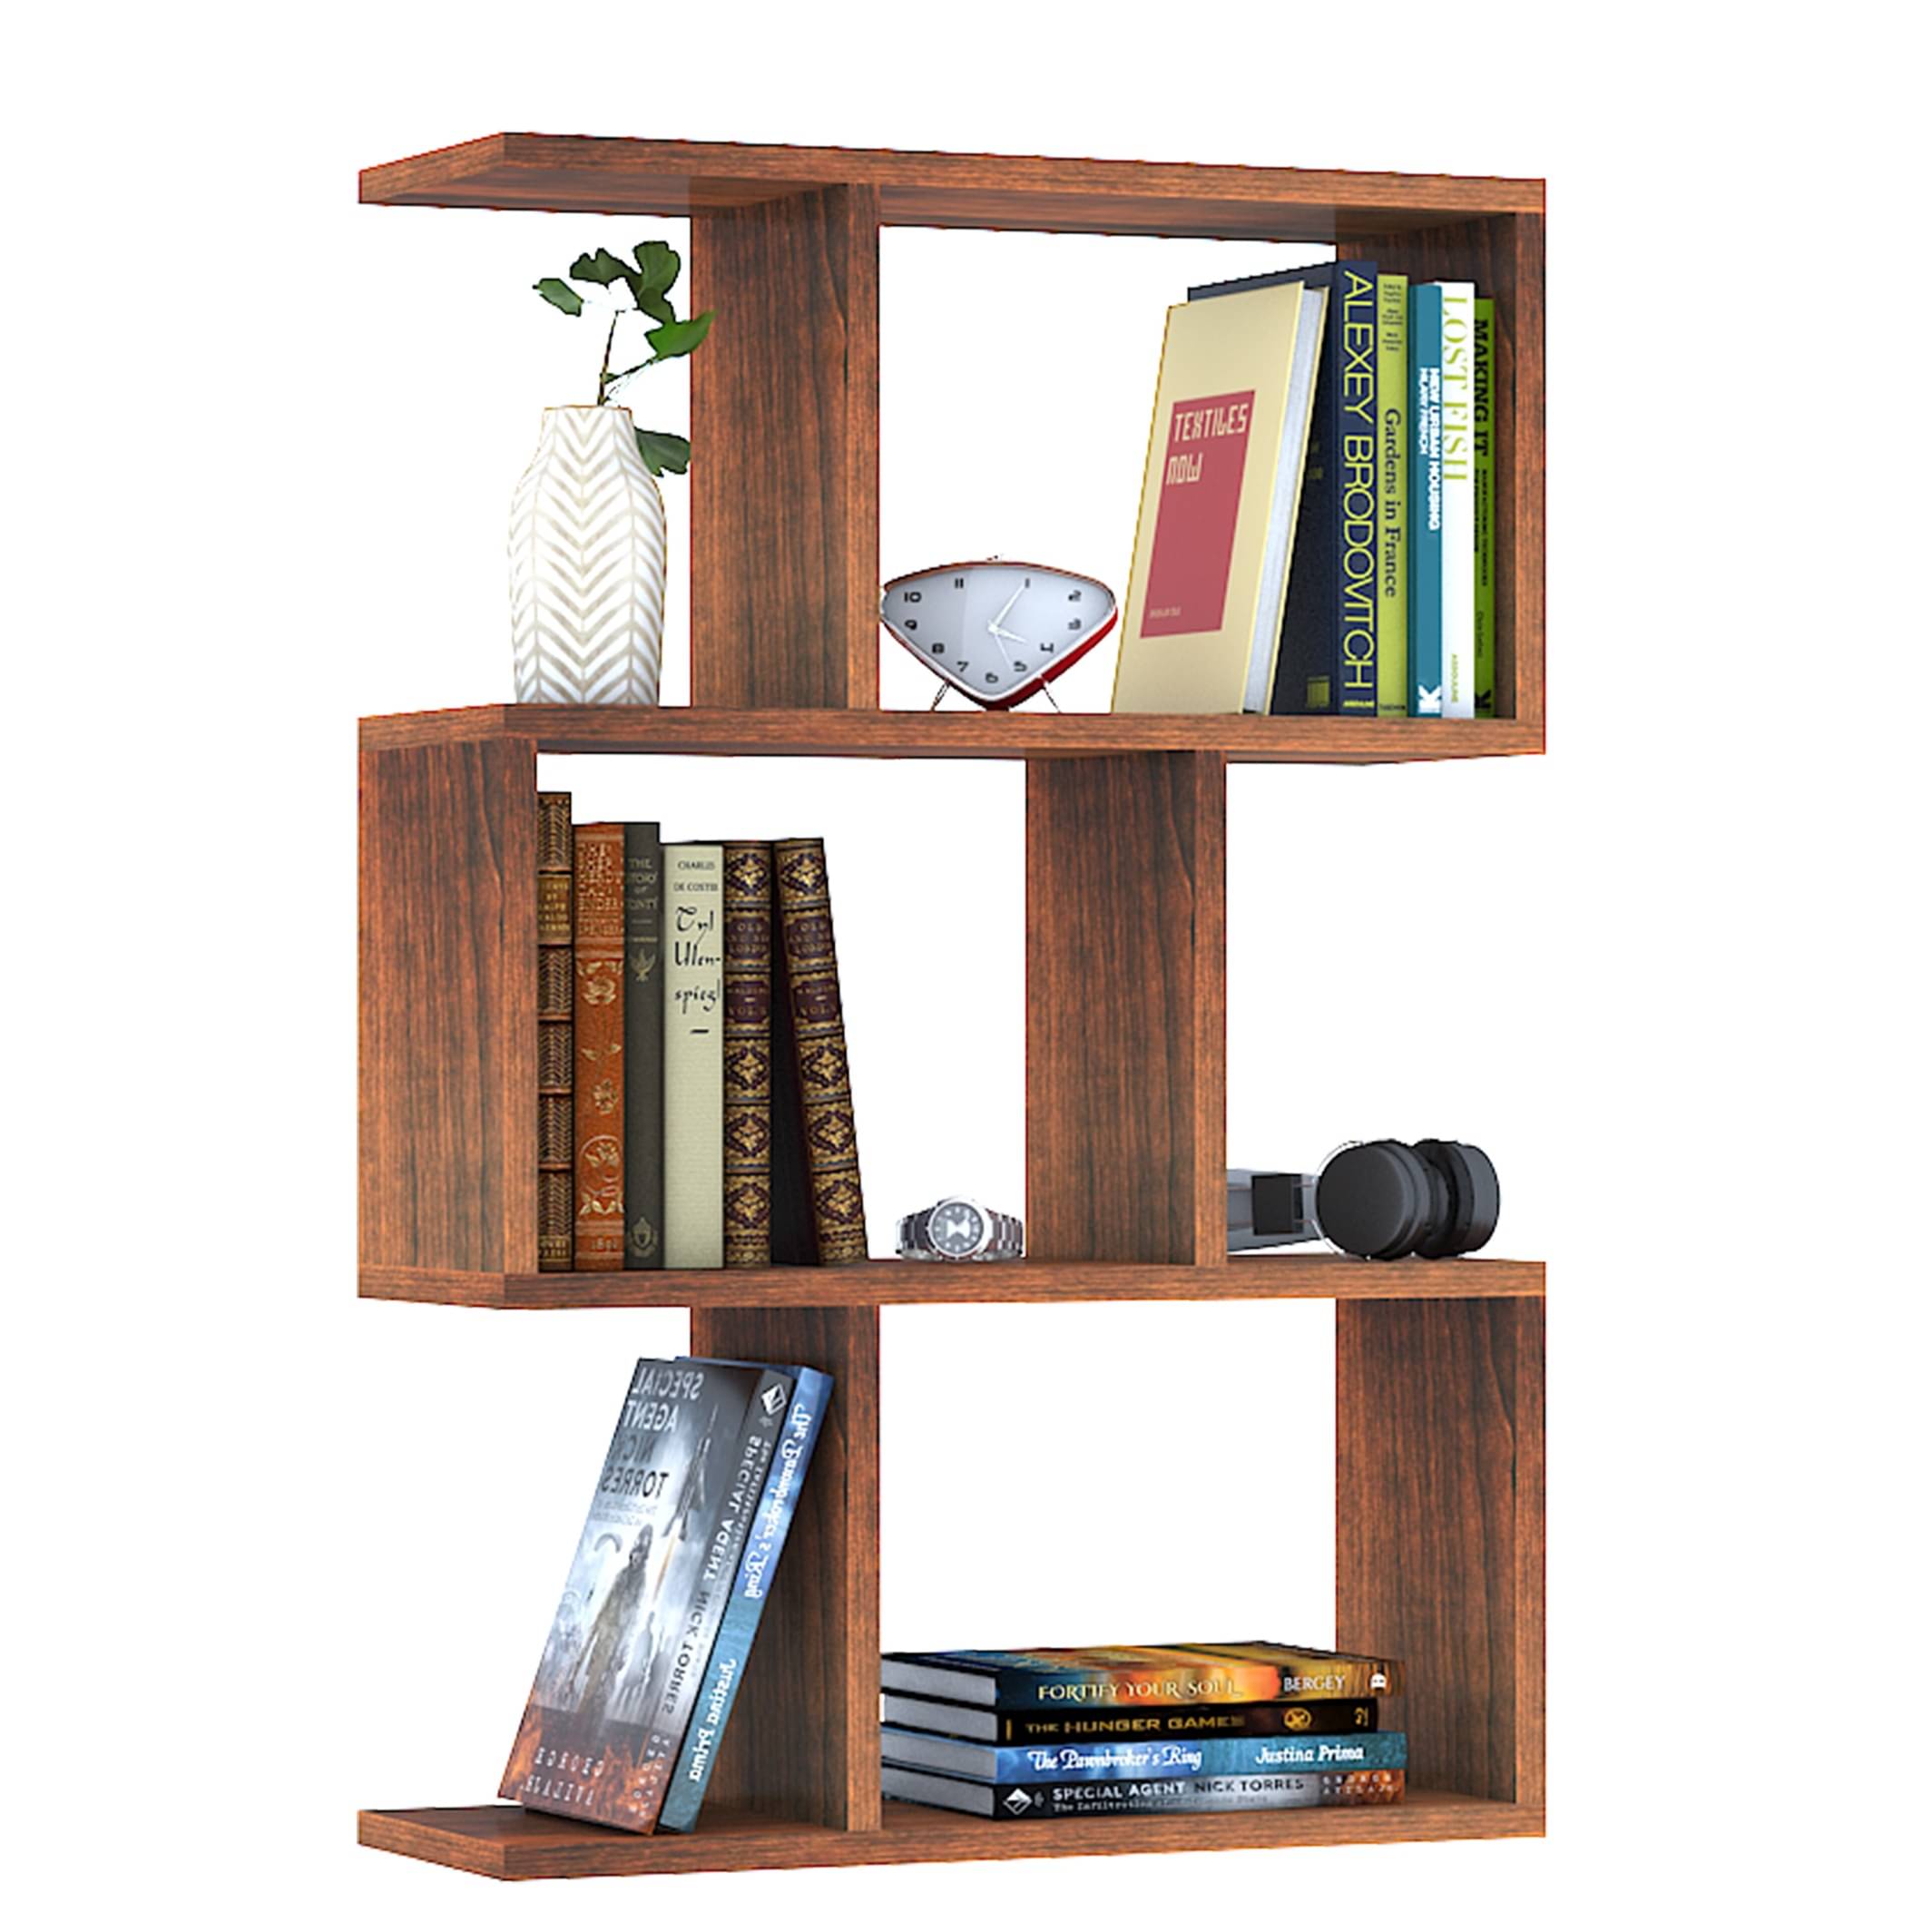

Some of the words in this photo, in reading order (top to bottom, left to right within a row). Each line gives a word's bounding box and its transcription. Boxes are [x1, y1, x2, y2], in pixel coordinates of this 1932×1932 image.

[1344, 270, 1374, 424] ALEXEY
[1442, 297, 1468, 389] LOST
[1474, 319, 1489, 423] MAKING
[1428, 368, 1440, 402] NEW
[1173, 403, 1249, 442] TEXTILES
[1428, 406, 1440, 457] URBAN
[1385, 408, 1401, 494] Gardens
[1442, 401, 1468, 480] FISH
[1474, 430, 1489, 456] IT
[1166, 453, 1202, 485] NOW
[1428, 461, 1440, 531] HOUSING
[1386, 500, 1401, 520] in
[1344, 436, 1374, 688] BRODOVITCH
[1385, 527, 1401, 597] France
[955, 578, 964, 588] 11
[1025, 578, 1031, 588] 1
[905, 592, 922, 603] 10
[1068, 591, 1082, 601] 2
[905, 619, 917, 631] 9
[932, 642, 945, 653] 8
[956, 661, 969, 672] 7
[986, 672, 998, 683] 6
[1014, 662, 1027, 672] 5
[1038, 1684, 1119, 1702] FORTIFY
[1125, 1682, 1182, 1700] YOUR
[1187, 1679, 1245, 1697] SOUL
[1283, 1675, 1346, 1692] BERGEY
[1026, 1722, 1058, 1734] THE
[1064, 1718, 1162, 1734] HUNGER
[1167, 1714, 1245, 1731] GAMES
[1027, 1749, 1058, 1770] The
[1060, 1747, 1160, 1770] Pawnbroker's
[1162, 1744, 1202, 1770] Ring
[1256, 1746, 1315, 1764] Justina
[1317, 1743, 1364, 1762] Prima
[1052, 1786, 1123, 1801] SPECIAL
[1128, 1780, 1186, 1797] AGENT
[1193, 1780, 1235, 1794] NICK
[1239, 1778, 1305, 1793] TORRES
